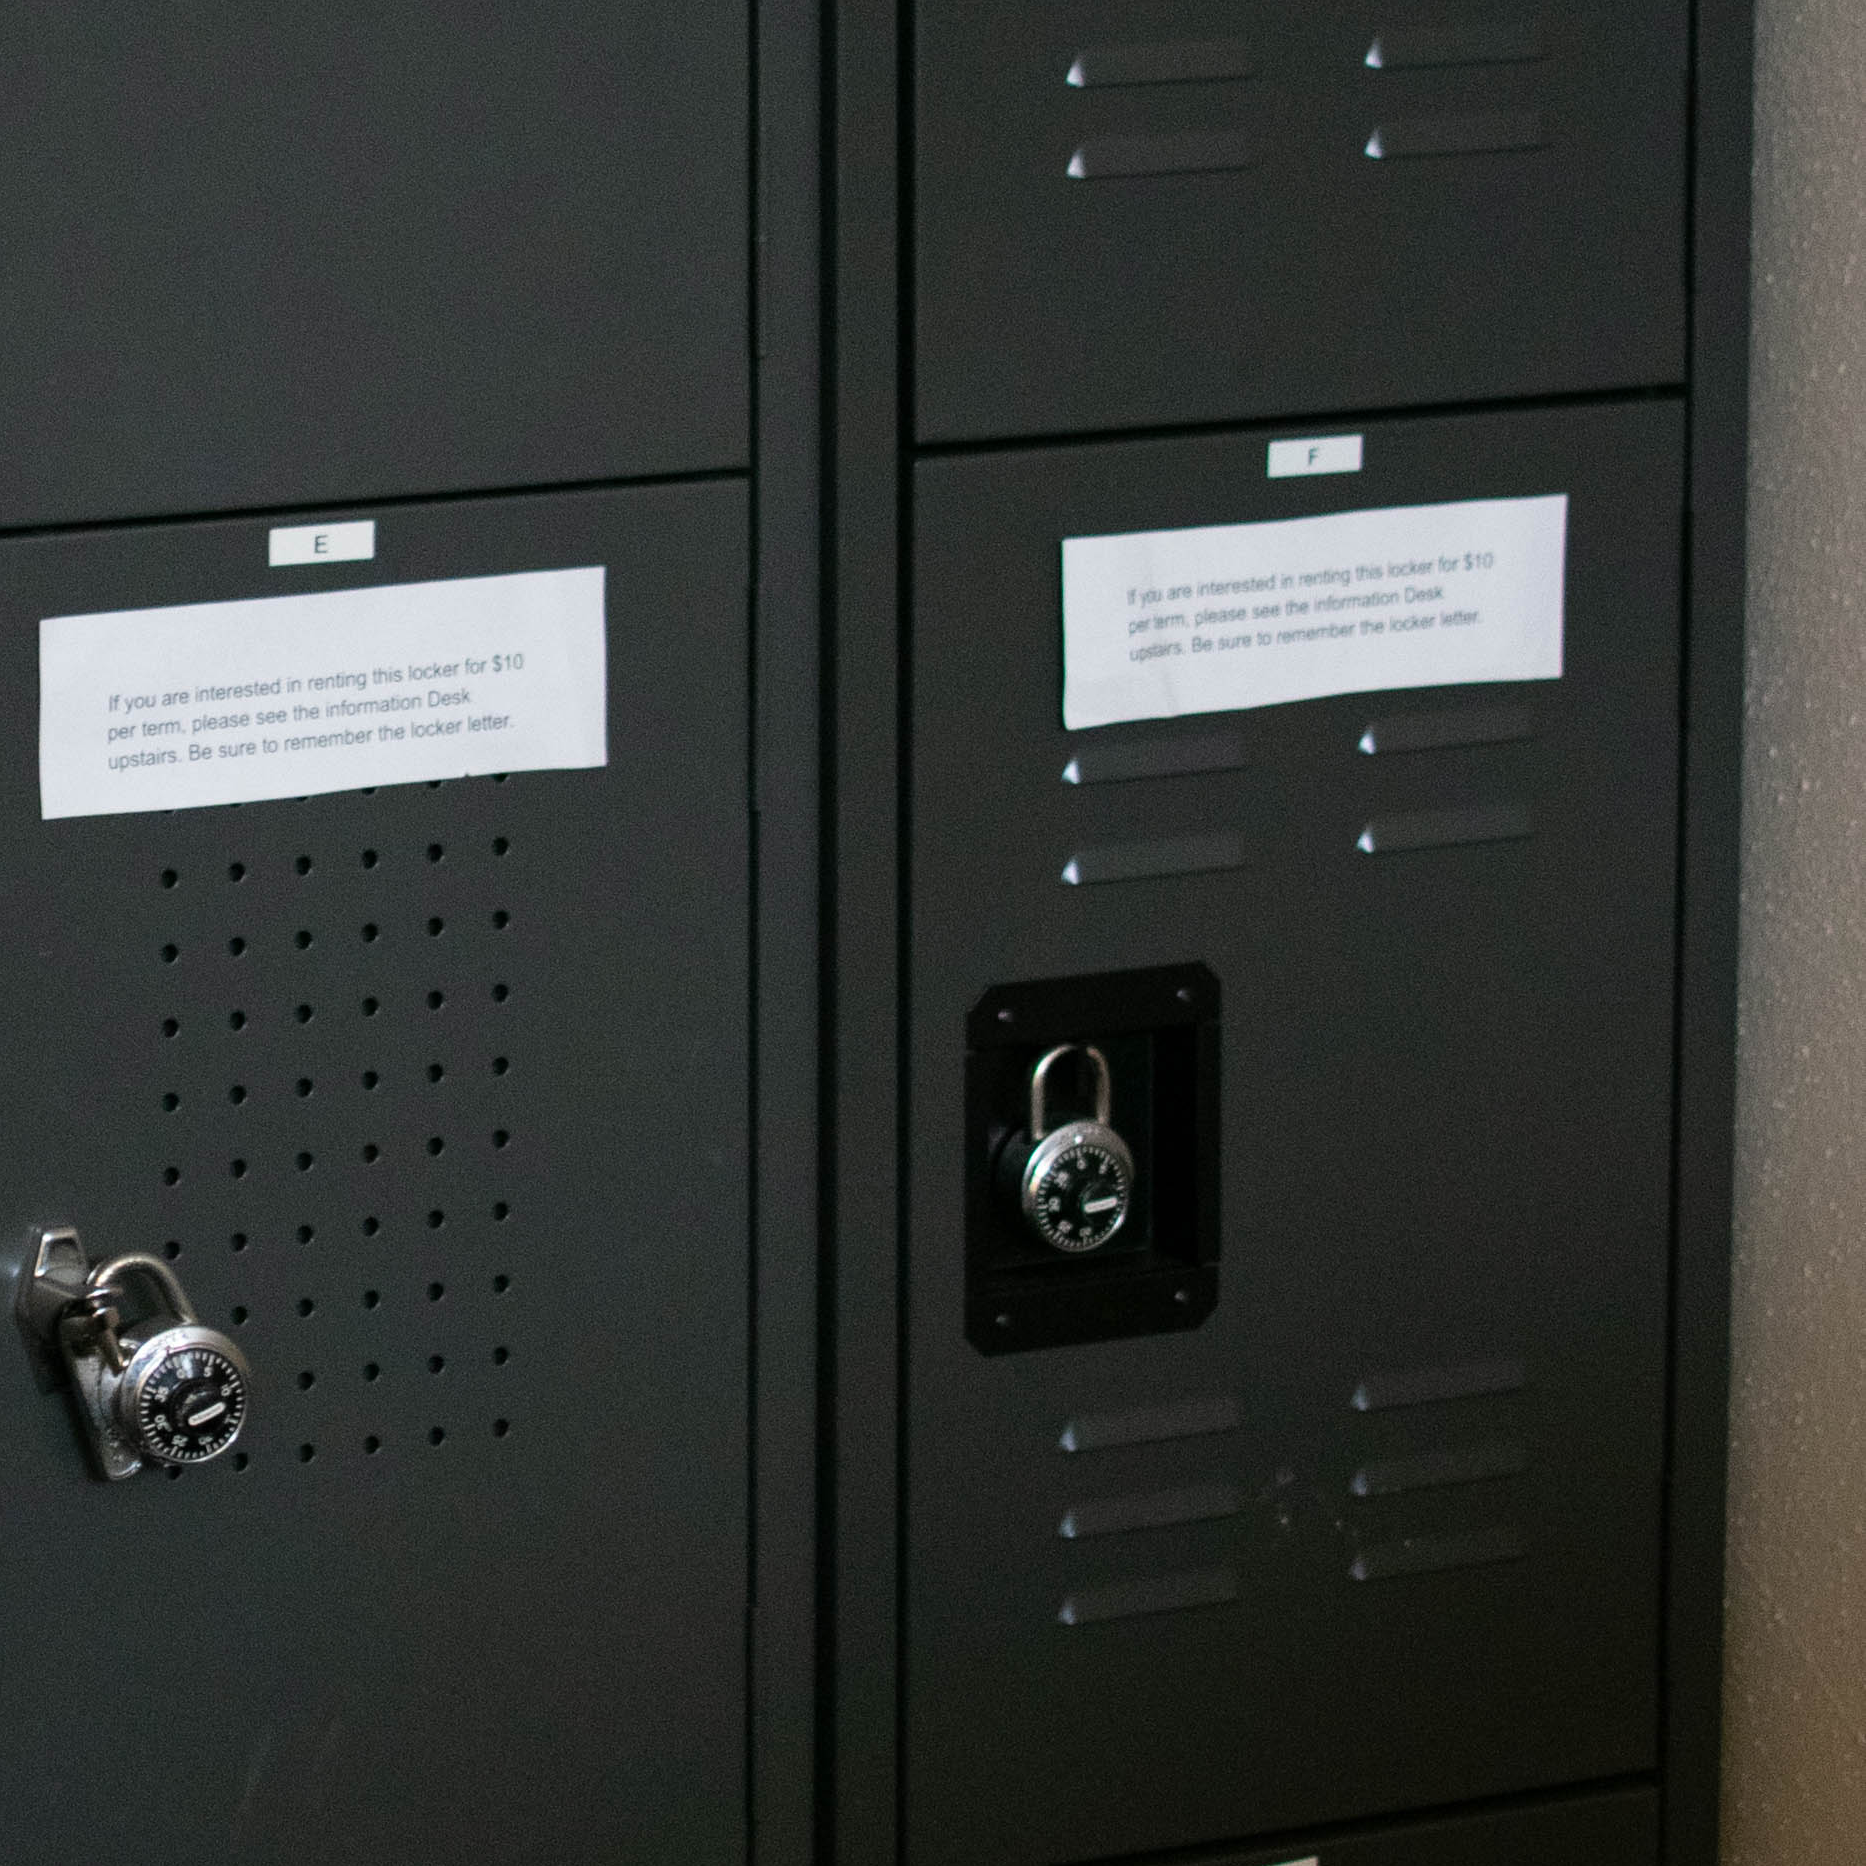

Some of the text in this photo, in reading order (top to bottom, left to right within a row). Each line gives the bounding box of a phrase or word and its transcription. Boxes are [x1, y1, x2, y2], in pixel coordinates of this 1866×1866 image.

[1308, 446, 1319, 466] F
[314, 534, 329, 554] E
[1126, 550, 1495, 608] If you are interested in renting this locker for $10
[1128, 619, 1150, 637] per
[1194, 607, 1247, 629] please
[1252, 604, 1281, 618] see
[1285, 598, 1309, 615] the
[1404, 584, 1443, 603] Desk
[1190, 636, 1214, 653] Be
[1216, 635, 1253, 650] sure
[1256, 631, 1273, 645] to
[1275, 621, 1355, 643] remember
[1359, 617, 1386, 634] the
[1388, 613, 1436, 632] locker
[108, 652, 525, 714] If you are interested in renting this locker for $10
[106, 726, 137, 745] per
[191, 713, 251, 735] please
[255, 710, 288, 725] see
[292, 702, 321, 721] the
[426, 687, 472, 708] Desk
[107, 715, 513, 772] upstairs. Be sure to remember the locker letter.
